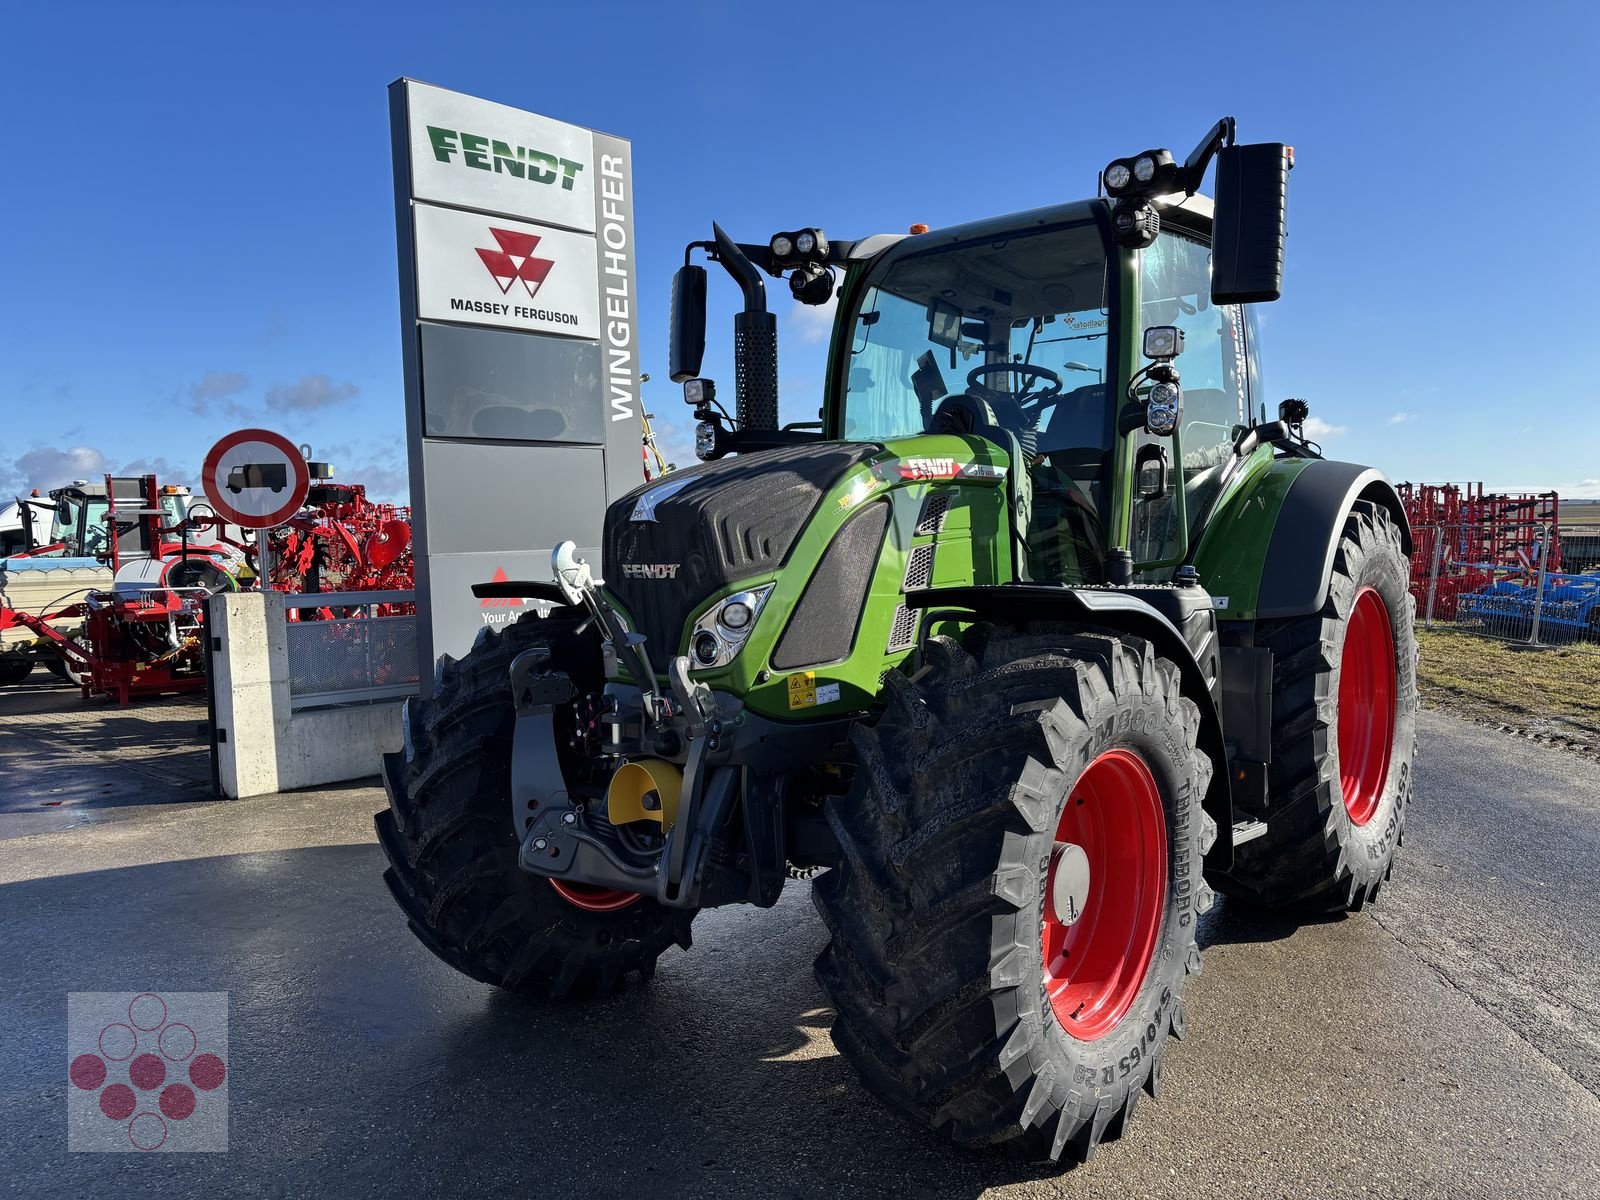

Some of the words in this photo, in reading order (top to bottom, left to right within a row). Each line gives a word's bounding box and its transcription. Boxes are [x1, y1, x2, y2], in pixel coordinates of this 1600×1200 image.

[426, 125, 584, 191] FENDT
[601, 153, 634, 422] WINGELHOFER
[450, 298, 510, 316] MASSEY
[514, 306, 579, 326] FERGUSON
[907, 458, 954, 476] FENDT
[622, 563, 681, 579] FENDT
[482, 611, 506, 624] Your
[1174, 777, 1191, 929] TRELLEBORG
